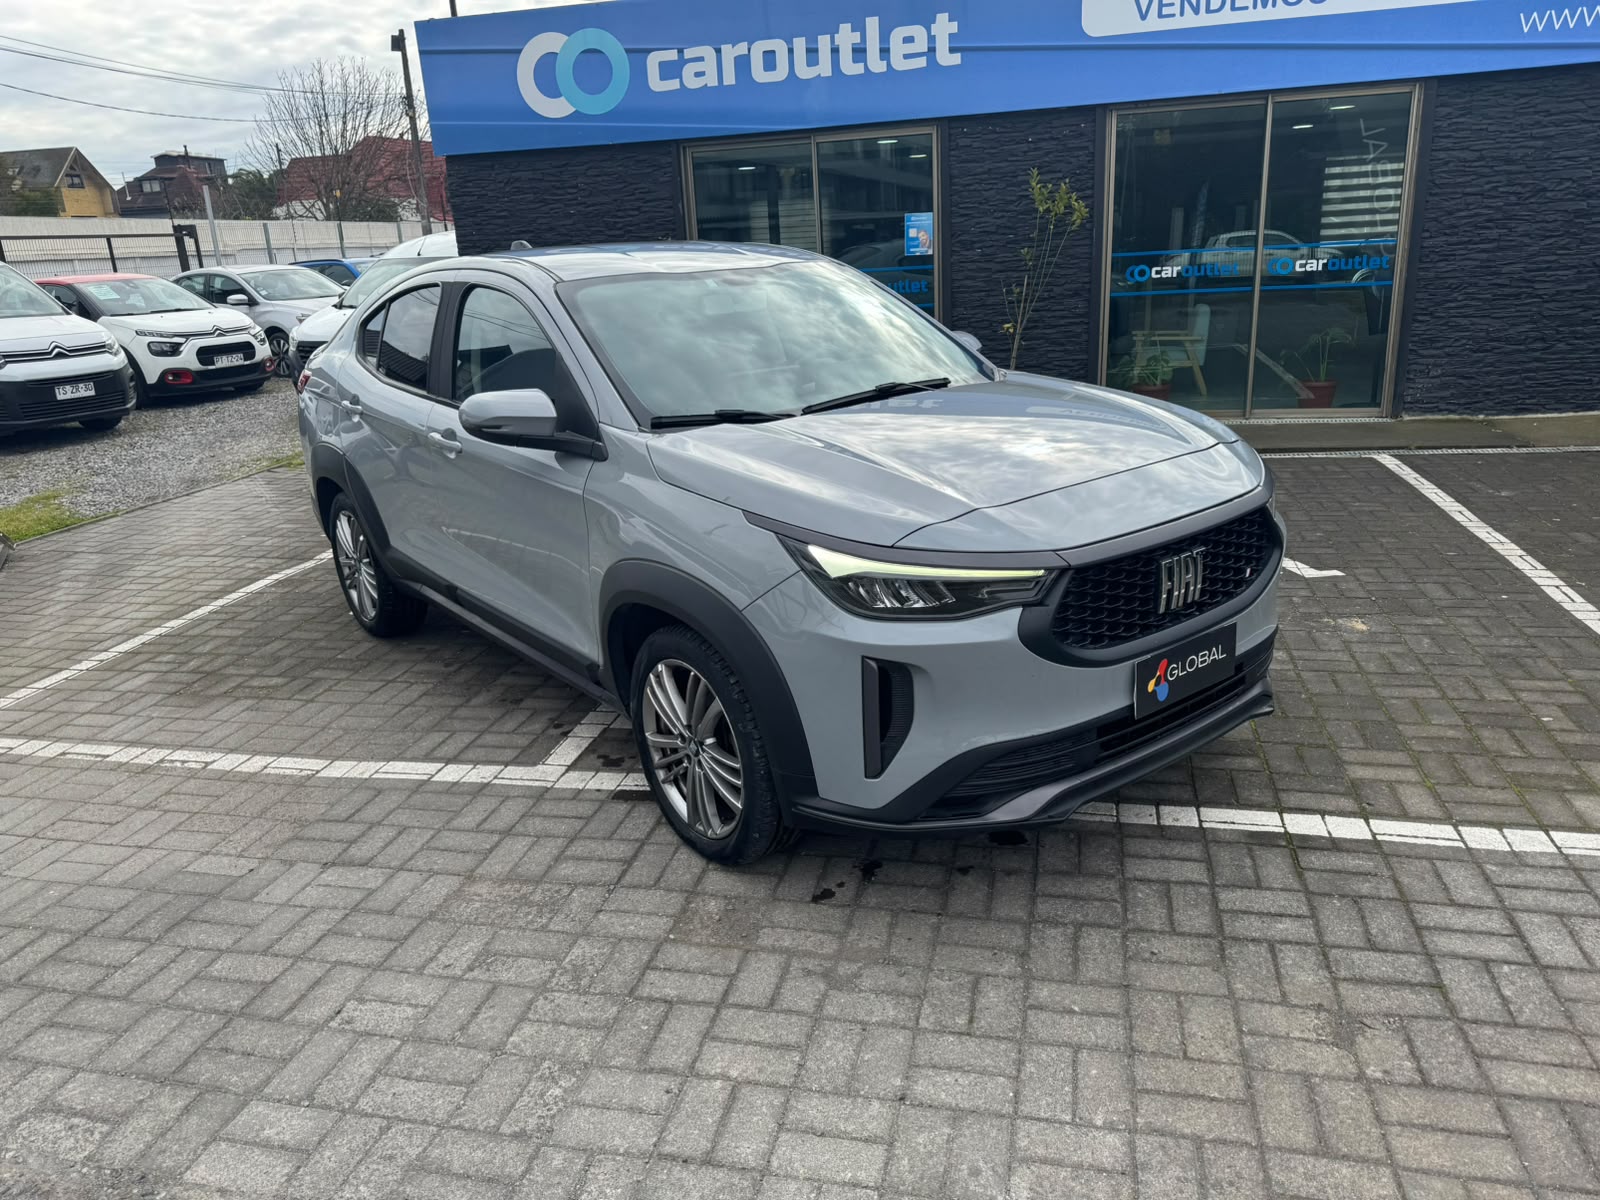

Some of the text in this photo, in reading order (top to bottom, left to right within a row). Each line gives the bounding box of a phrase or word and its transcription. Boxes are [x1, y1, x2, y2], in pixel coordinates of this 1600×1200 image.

[1134, 0, 1328, 21] VEND
[647, 13, 962, 92] caroutlet
[1295, 255, 1390, 272] caroutlet
[1159, 547, 1206, 614] FIAT
[1167, 645, 1227, 681] GLOBAL
